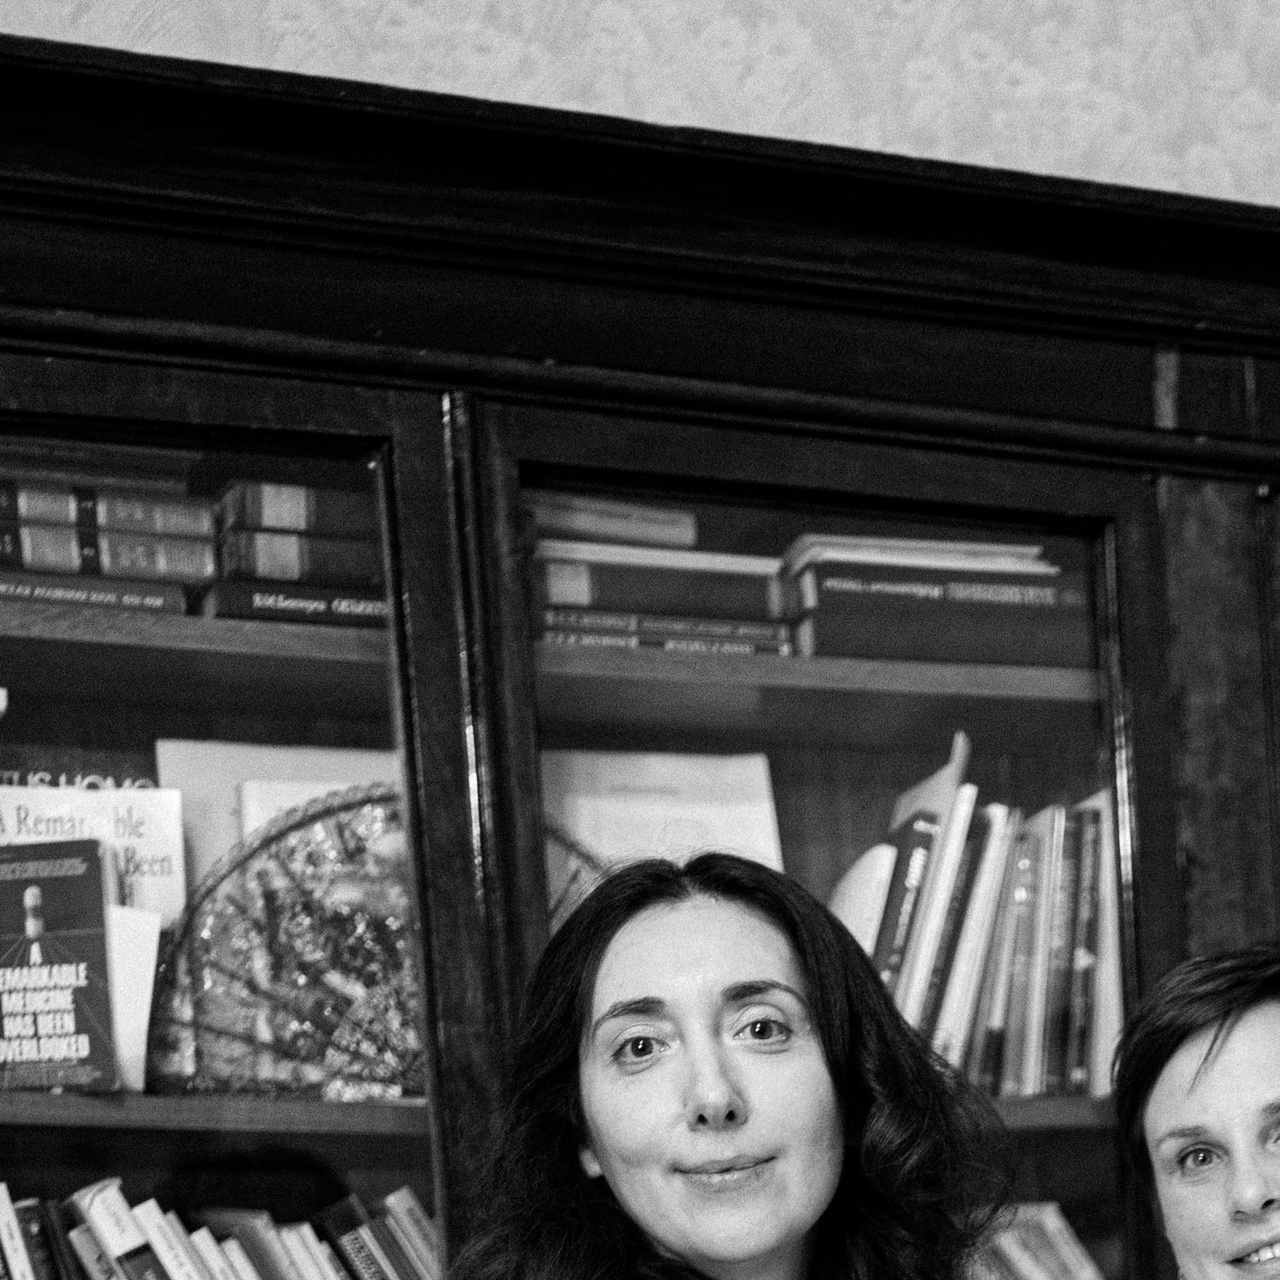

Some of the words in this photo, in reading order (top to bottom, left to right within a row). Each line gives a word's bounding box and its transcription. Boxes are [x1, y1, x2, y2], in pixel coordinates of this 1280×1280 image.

[29, 941, 43, 966] A
[4, 1013, 36, 1038] HAS
[37, 1011, 76, 1036] BEEN
